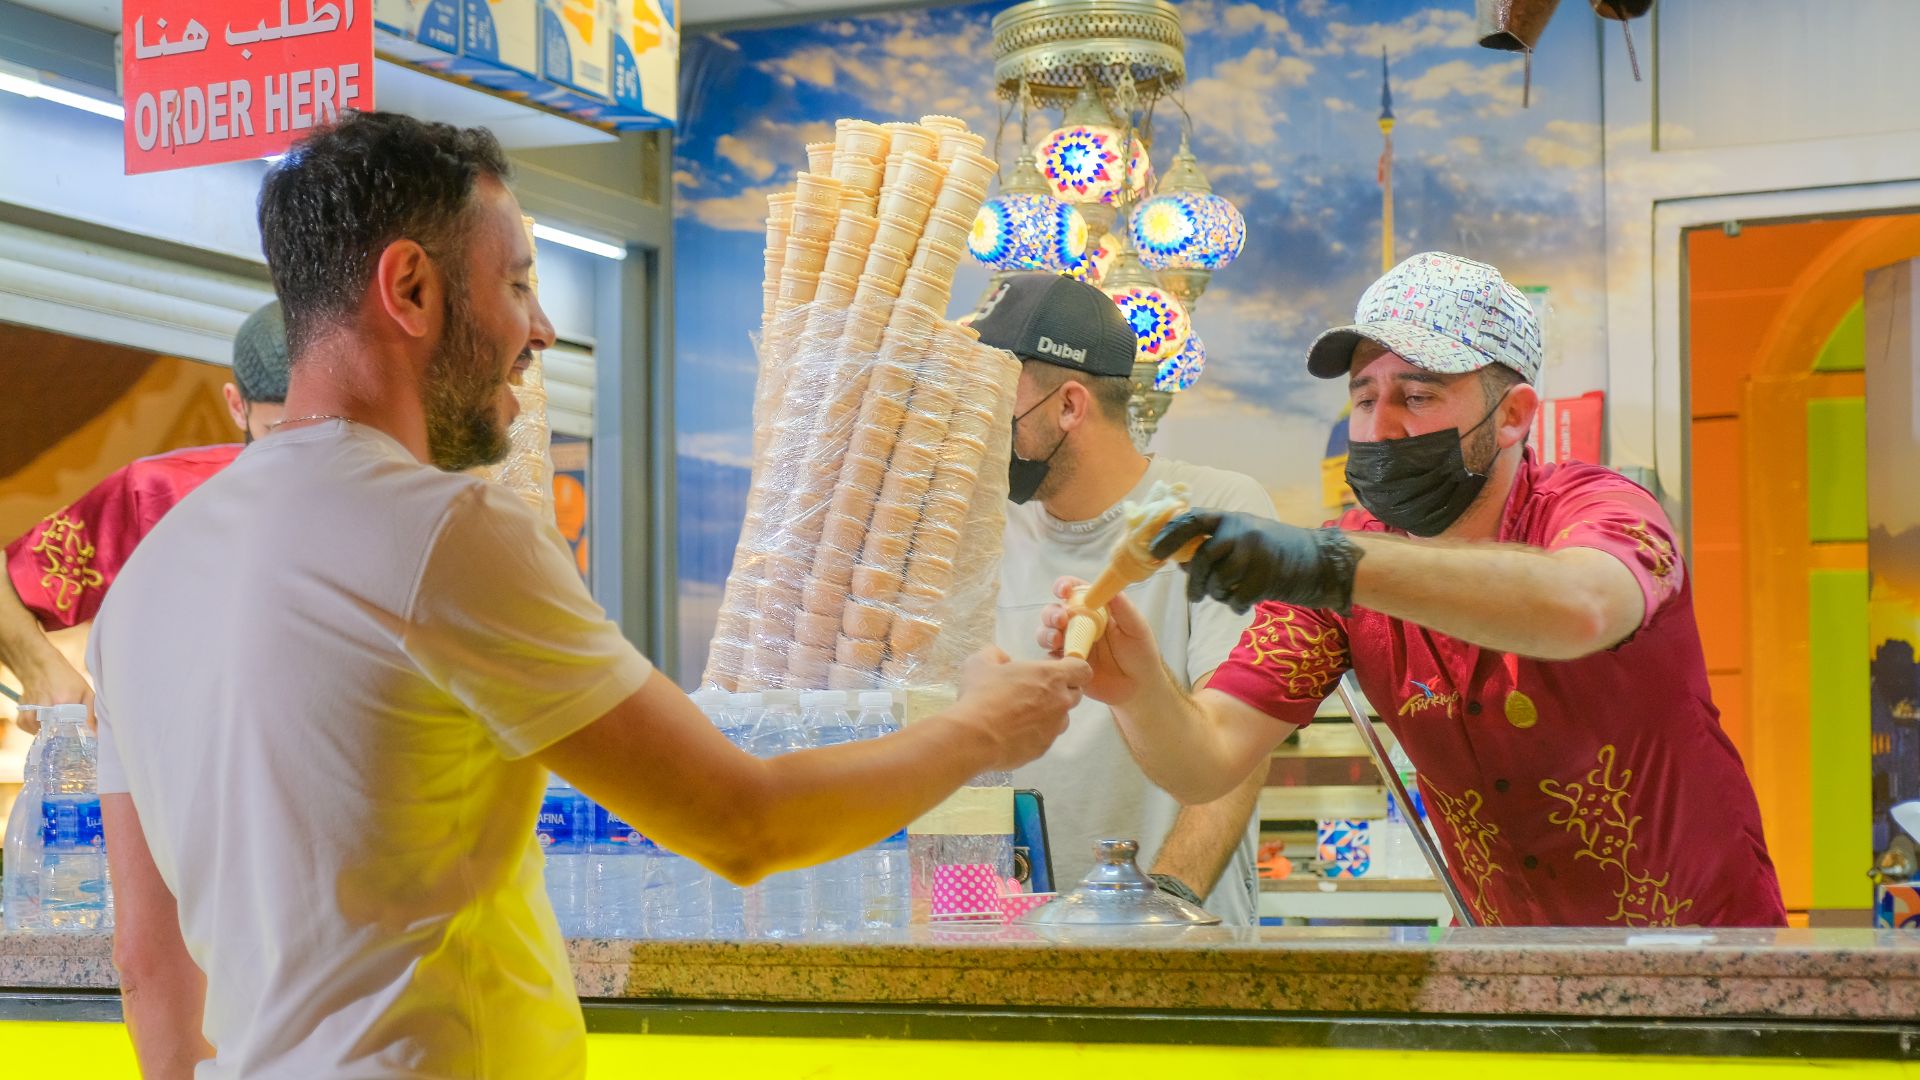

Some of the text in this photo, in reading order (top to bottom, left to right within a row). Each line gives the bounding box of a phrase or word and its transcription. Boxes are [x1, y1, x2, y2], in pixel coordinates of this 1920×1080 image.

[135, 15, 209, 60] هنا
[134, 63, 360, 152] ORDER HERE
